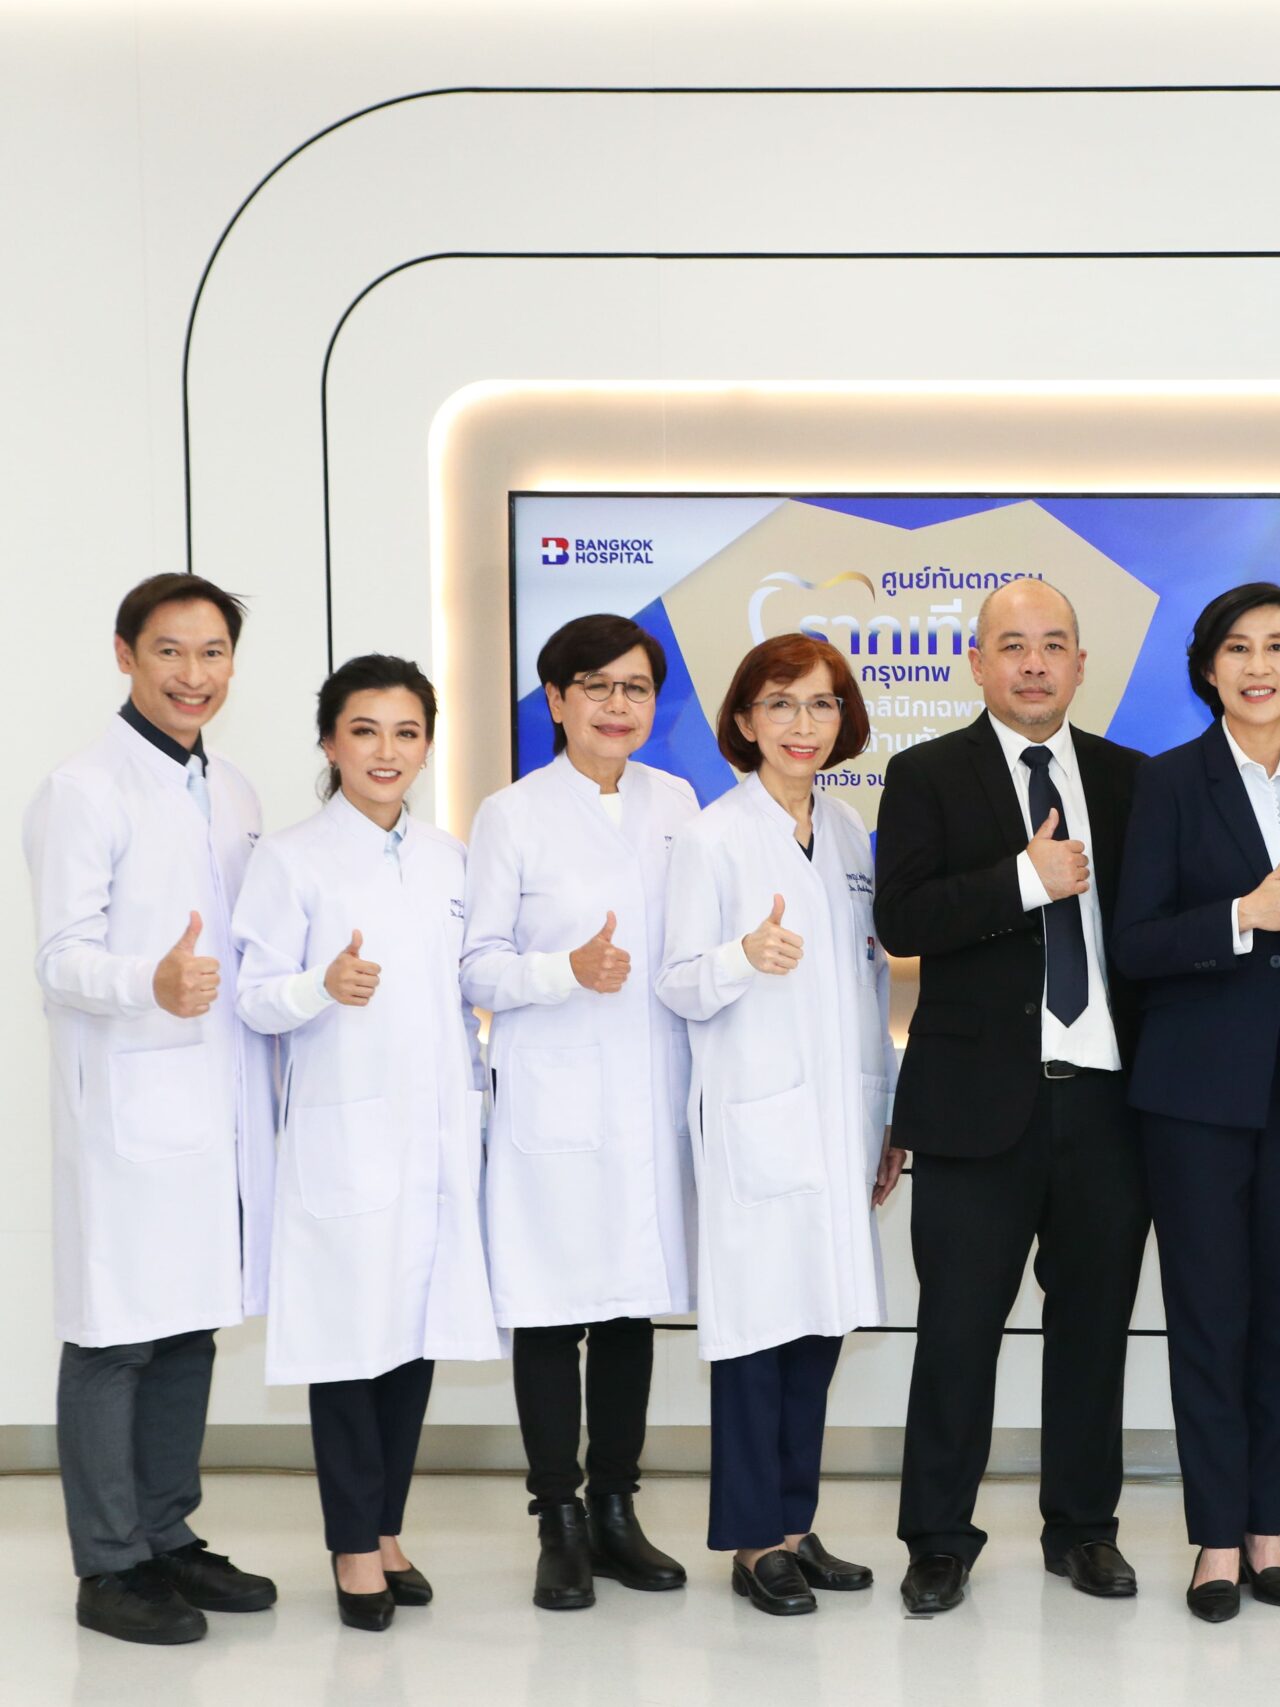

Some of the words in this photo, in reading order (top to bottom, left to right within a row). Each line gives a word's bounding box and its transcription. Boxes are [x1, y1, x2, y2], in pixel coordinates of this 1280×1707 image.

[575, 538, 654, 551] BANGKOK
[575, 552, 654, 564] HOSPITAL
[800, 598, 978, 655] รากเที
[861, 664, 951, 689] กรุงเทพ
